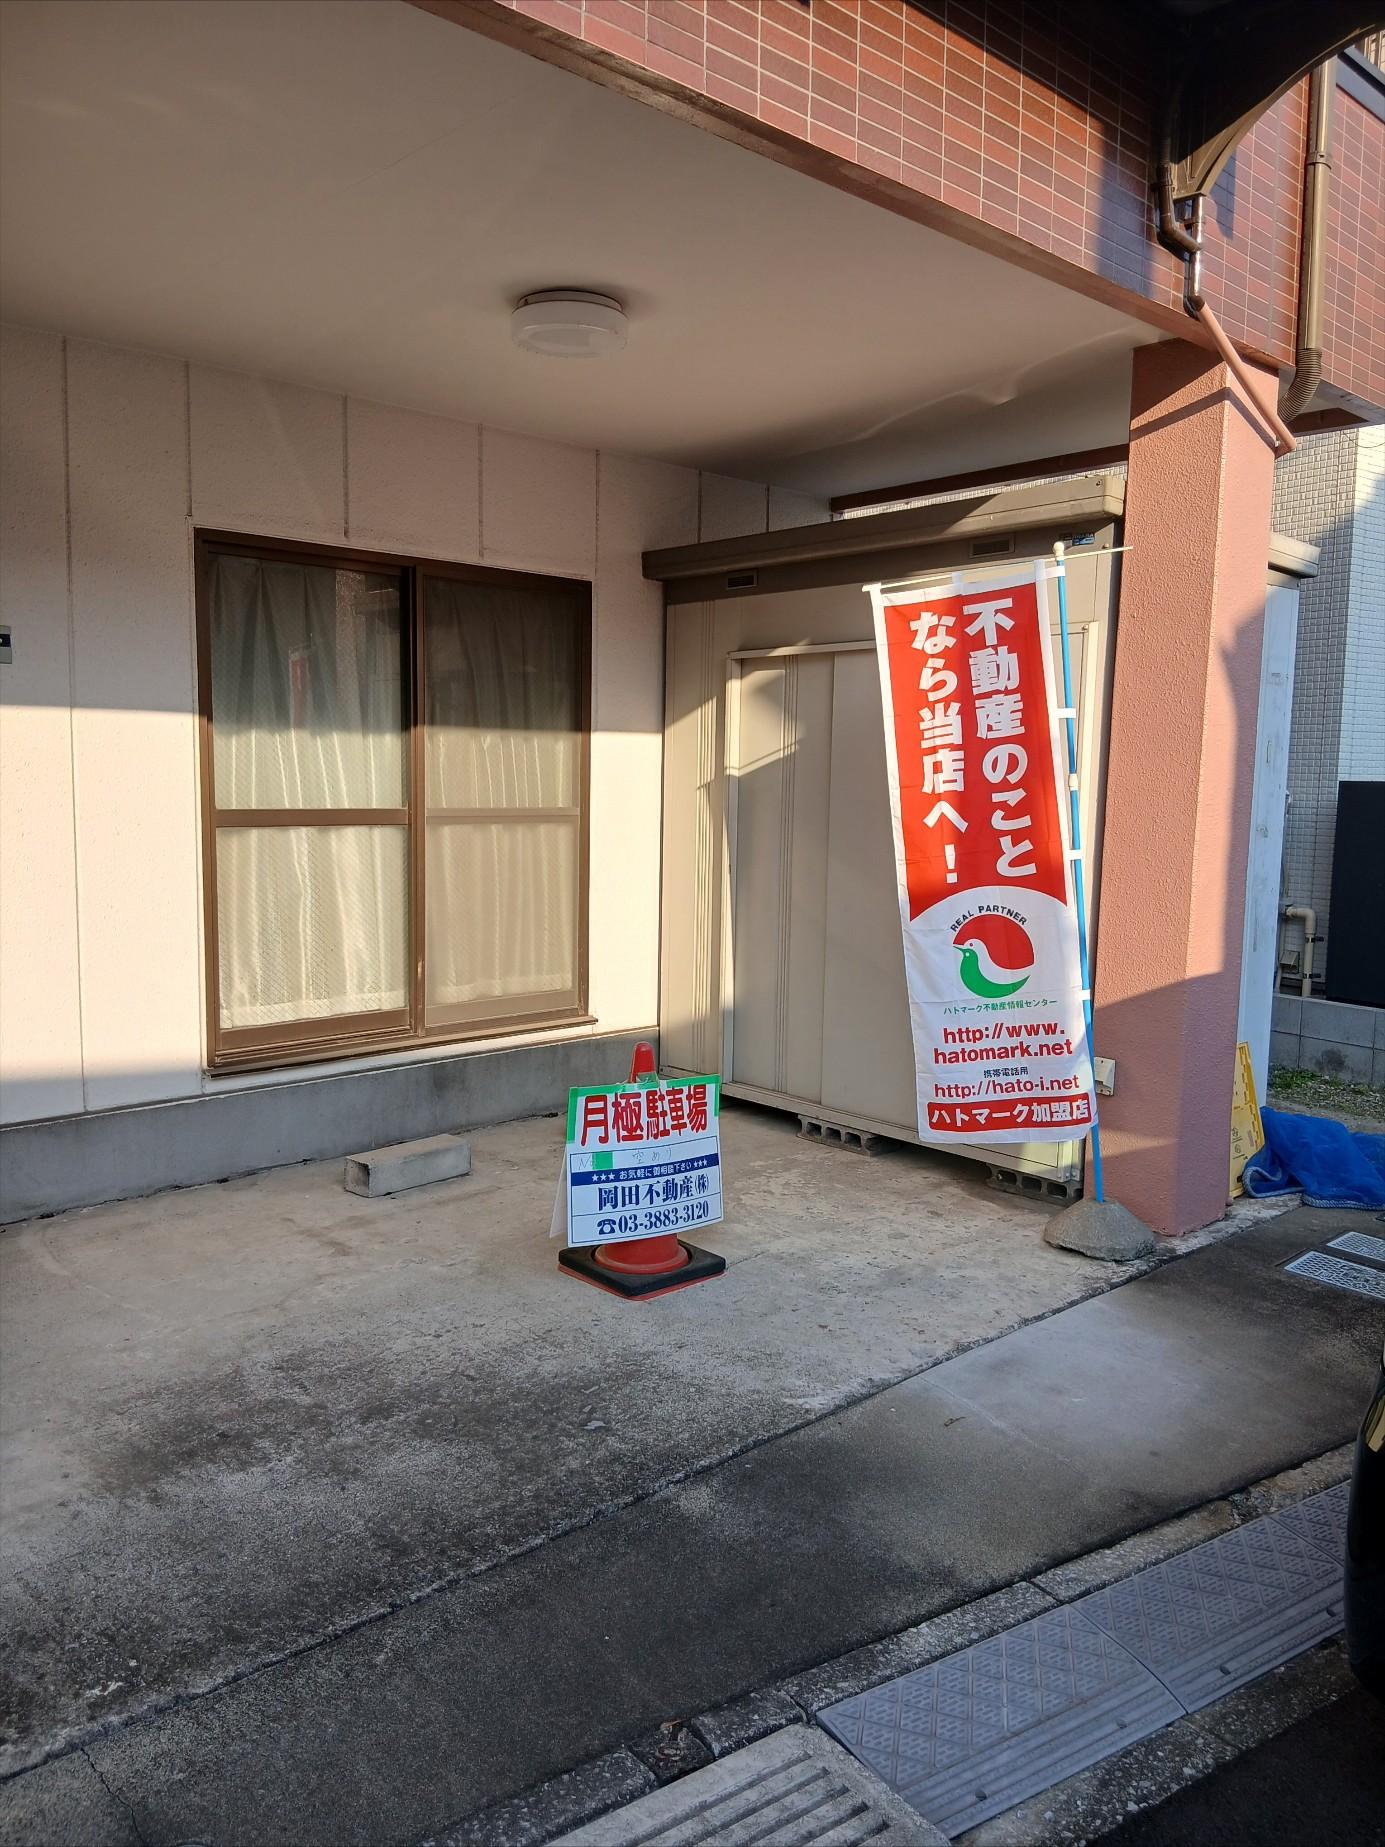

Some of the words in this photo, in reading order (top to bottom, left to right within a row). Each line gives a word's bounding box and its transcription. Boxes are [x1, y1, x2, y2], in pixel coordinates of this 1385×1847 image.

[909, 611, 969, 884] なら当店へ!
[962, 597, 1037, 878] 不動産のこと
[950, 910, 974, 932] REAL
[978, 904, 1028, 926] PARTNER
[943, 998, 1057, 1015] ハトマーク不動産情報センター
[943, 1022, 1065, 1044] http://www.
[933, 1038, 1073, 1065] hatomark.net
[983, 1066, 1029, 1079] 携帯電話用
[934, 1075, 1080, 1099] http://hato-i.net
[580, 1083, 708, 1147] 月極駐車場
[931, 1099, 1090, 1127] ハトマーク加盟店
[618, 1200, 709, 1234] 03-3883-3120
